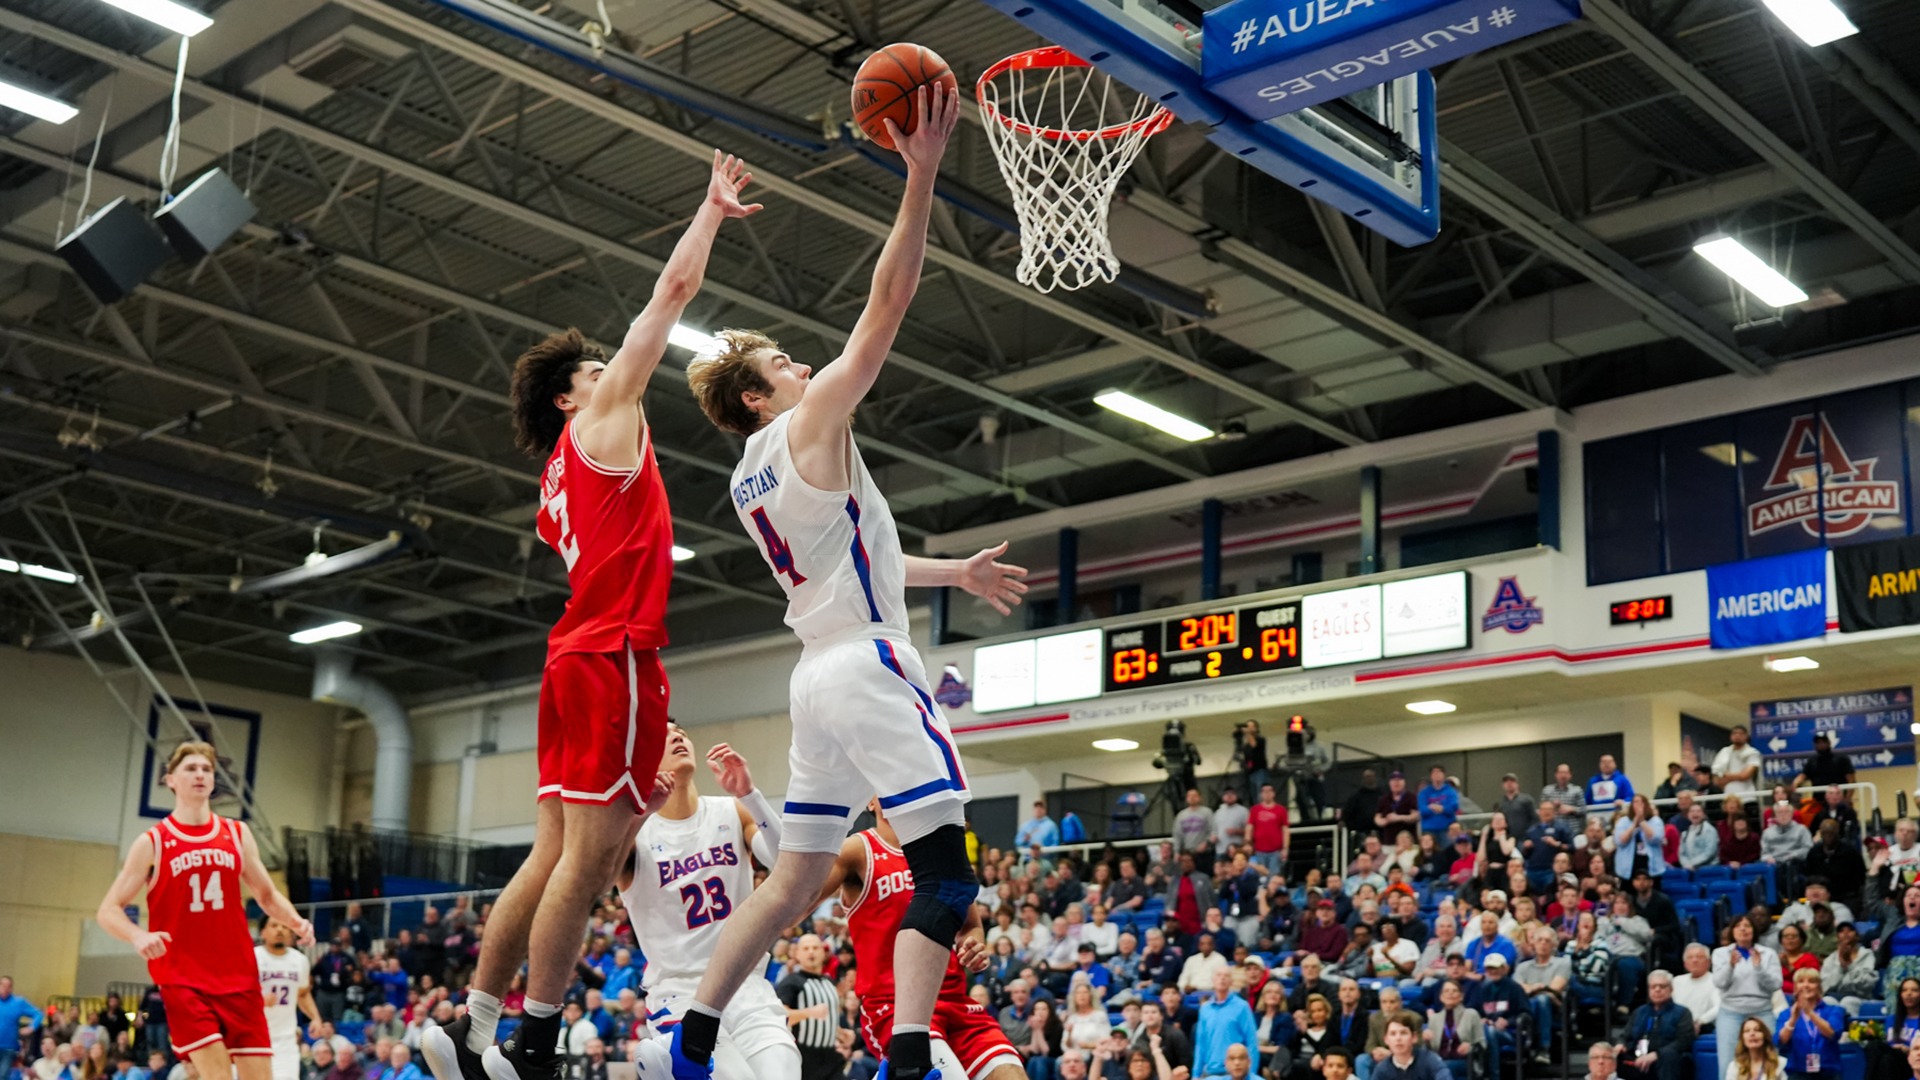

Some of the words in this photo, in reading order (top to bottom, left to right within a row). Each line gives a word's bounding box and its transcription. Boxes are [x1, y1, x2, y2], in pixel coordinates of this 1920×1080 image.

[1257, 6, 1517, 103] #AUEAGLES
[547, 489, 580, 573] 2
[750, 505, 808, 588] 4
[1256, 606, 1297, 628] GUEST
[1626, 598, 1665, 620] 2:01
[1716, 582, 1822, 620] AMERICAN
[1180, 614, 1236, 651] 2:04
[1312, 611, 1372, 640] EAGLES
[1261, 627, 1297, 662] 64
[1113, 648, 1147, 683] 63
[1206, 651, 1222, 678] 2
[1073, 704, 1137, 720] Character
[1141, 698, 1189, 712] Forged
[1194, 688, 1254, 704] Through
[1257, 675, 1350, 698] Competition
[1775, 697, 1833, 717] BENDER
[1836, 693, 1889, 711] ARENA
[1814, 715, 1848, 730] EXIT
[170, 848, 235, 877] BOSTON
[657, 842, 739, 888] EAGLES
[188, 870, 224, 912] 14
[876, 869, 916, 901] BOS
[680, 876, 732, 930] 23
